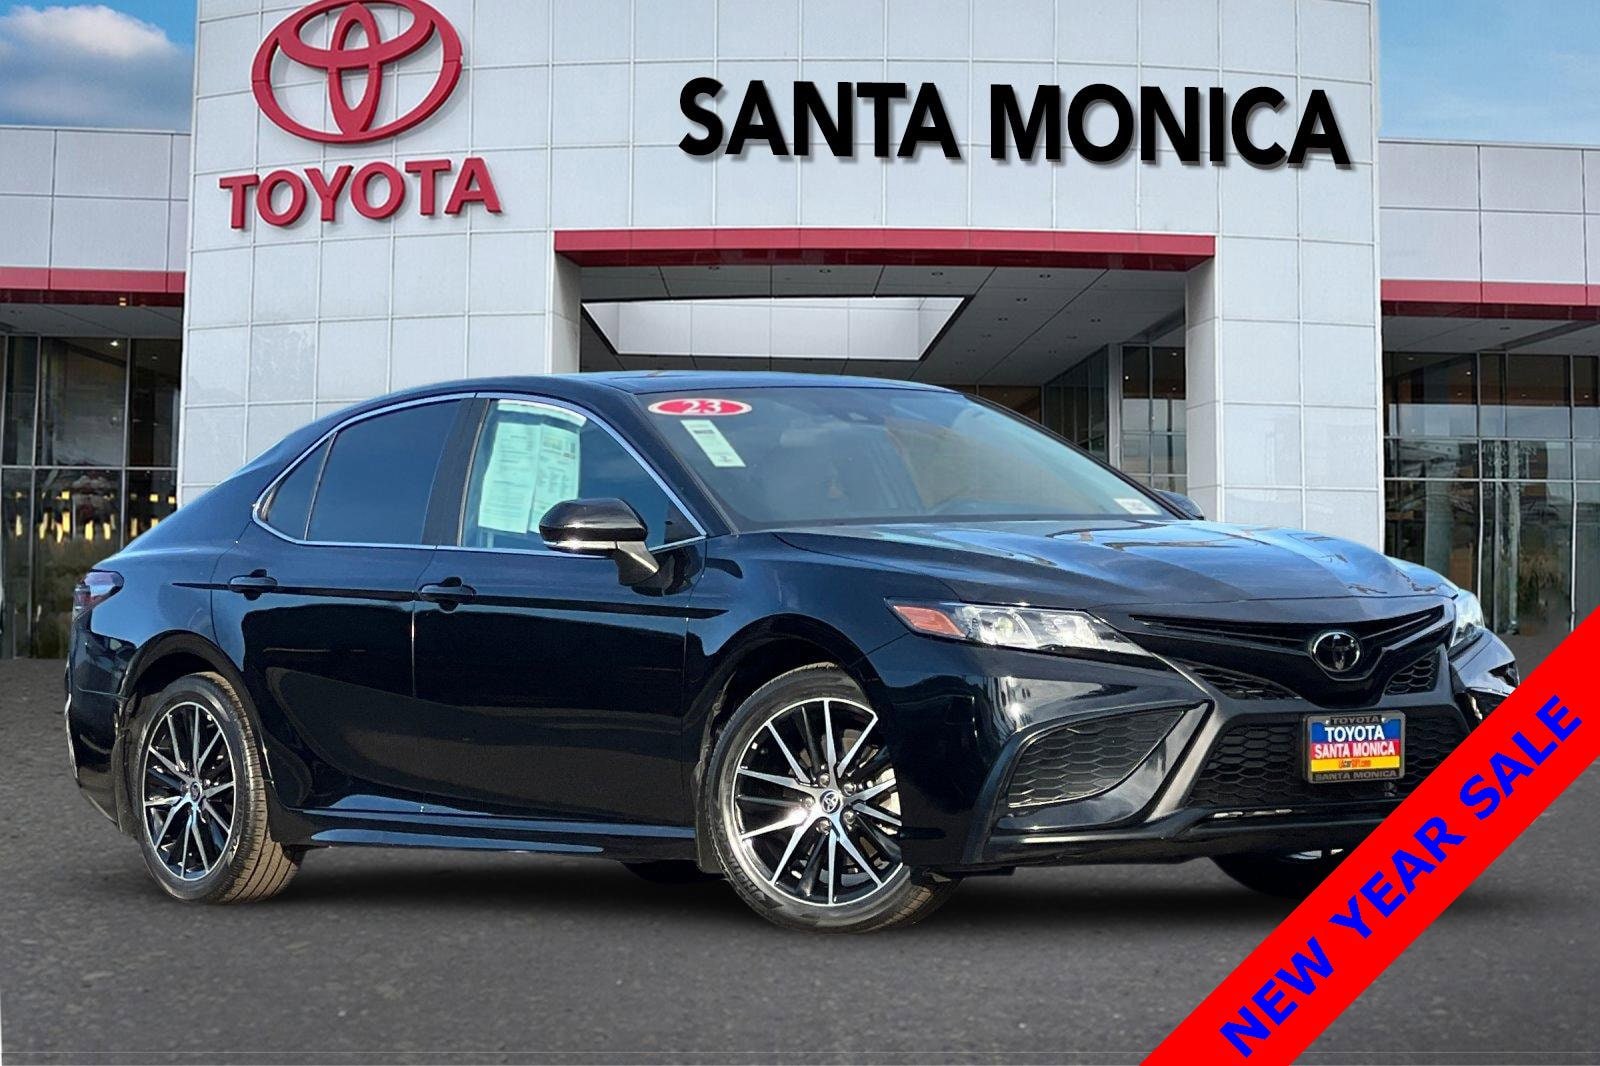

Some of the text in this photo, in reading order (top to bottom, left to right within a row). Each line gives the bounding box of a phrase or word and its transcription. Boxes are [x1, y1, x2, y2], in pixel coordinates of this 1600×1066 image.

[679, 77, 1351, 166] SANTA MONICA
[219, 157, 502, 229] TOYOTA
[681, 399, 722, 415] 23
[1331, 715, 1380, 725] TOYOTA
[1324, 725, 1385, 743] TOYOTA
[1314, 741, 1396, 759] SANTA MONICA
[1315, 769, 1398, 781] SANTA MONICA
